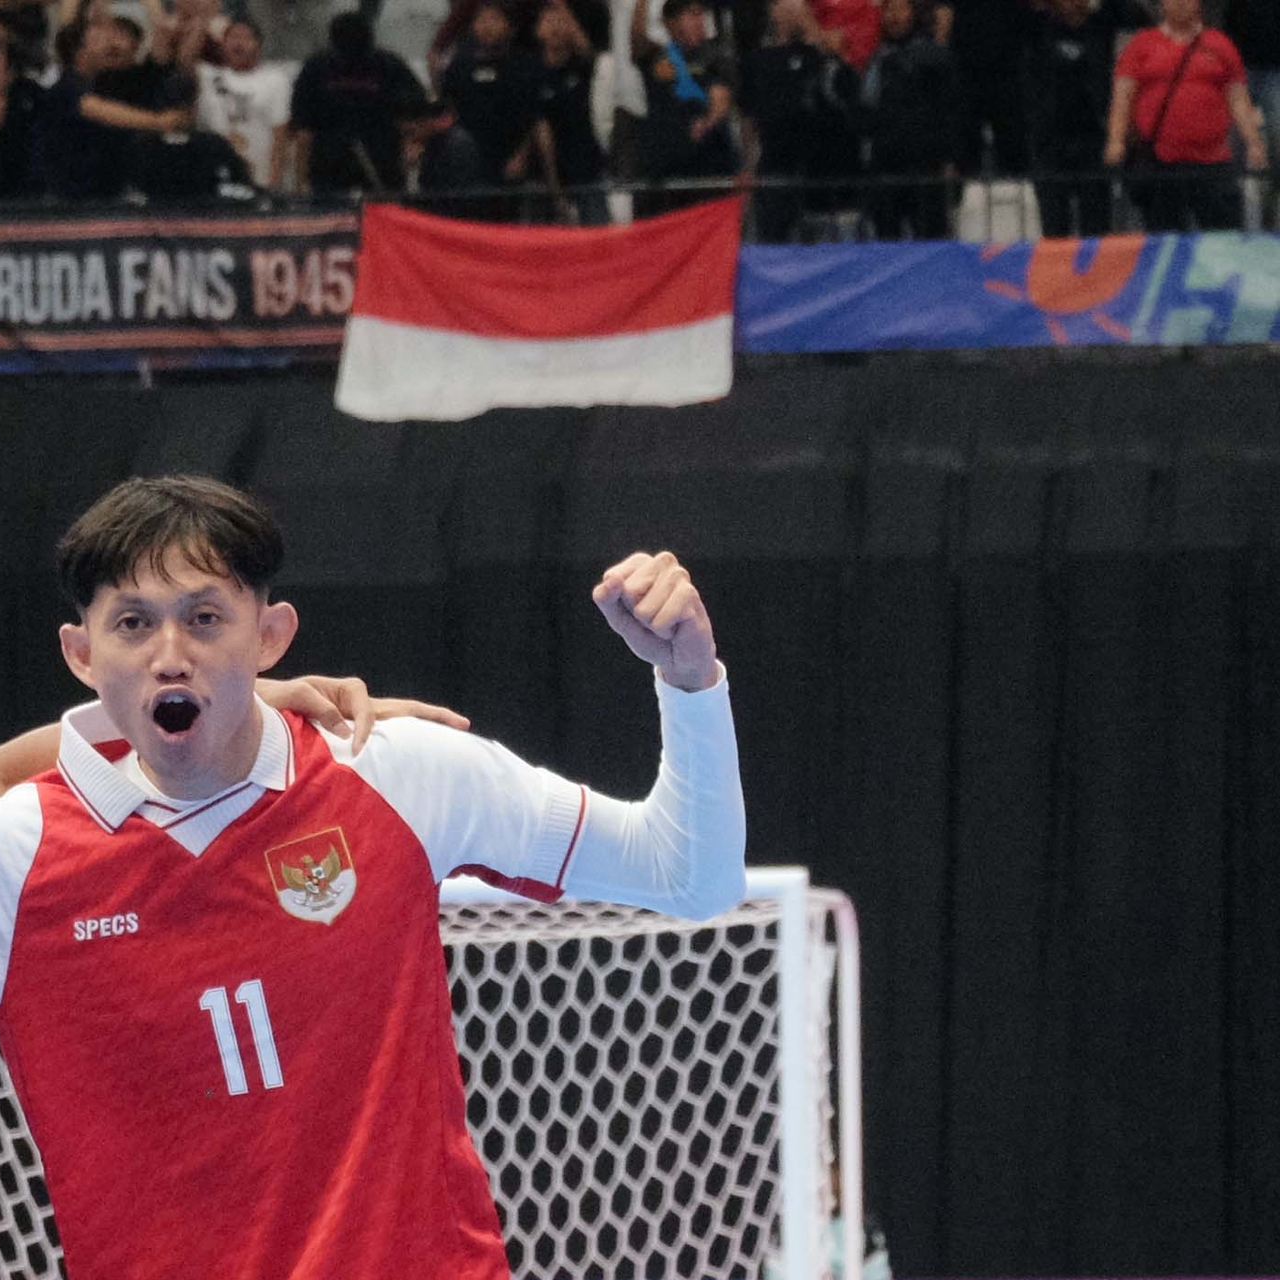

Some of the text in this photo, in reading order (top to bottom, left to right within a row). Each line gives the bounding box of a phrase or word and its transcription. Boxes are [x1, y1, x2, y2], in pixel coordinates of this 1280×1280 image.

[121, 250, 236, 321] FANS
[251, 248, 355, 317] 1945
[72, 911, 140, 942] SPECS
[198, 979, 285, 1096] 11
